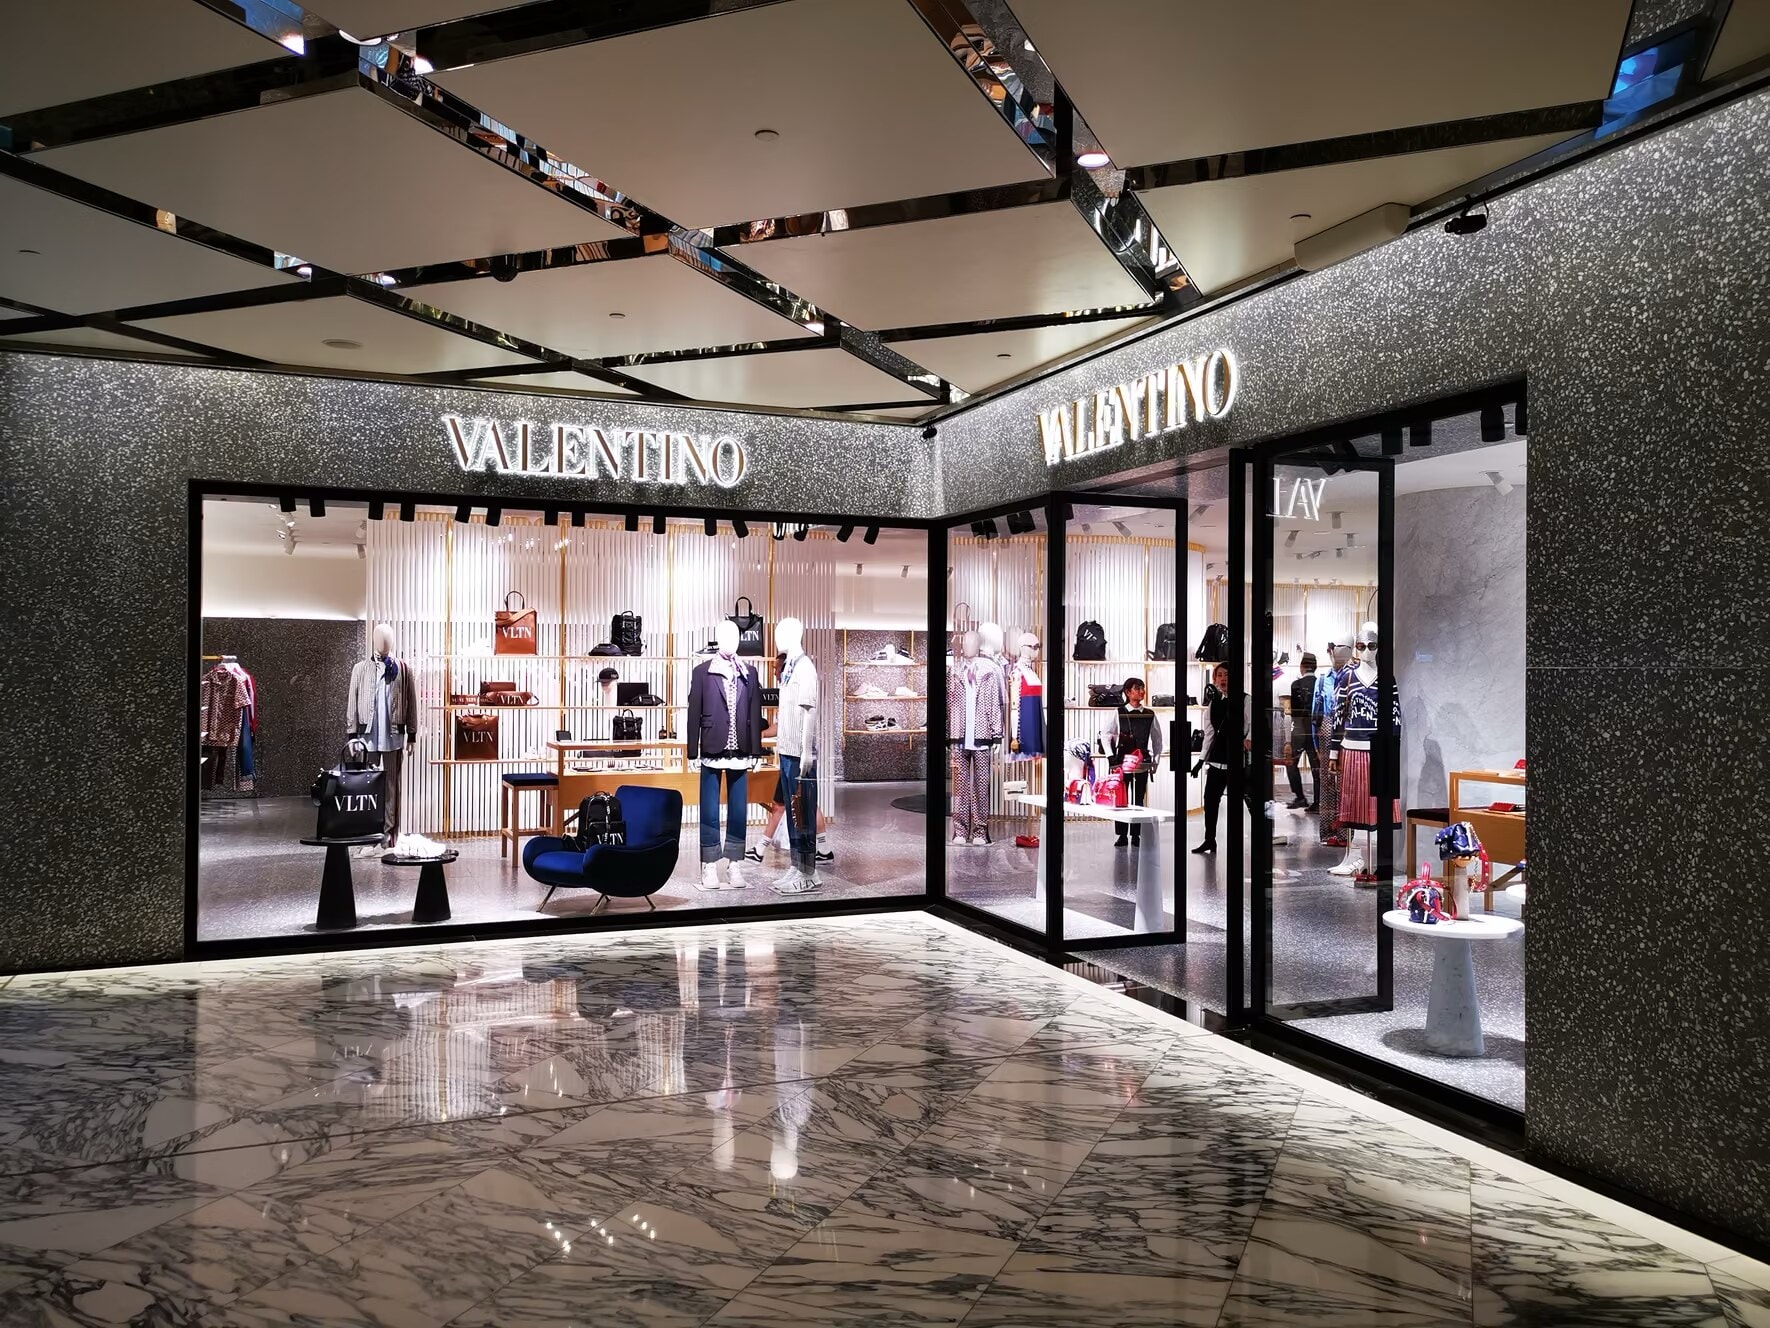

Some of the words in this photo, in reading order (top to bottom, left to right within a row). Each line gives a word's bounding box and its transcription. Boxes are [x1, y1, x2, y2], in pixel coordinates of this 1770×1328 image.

[1037, 349, 1238, 466] VALENTINO
[442, 416, 747, 488] VALENTINO
[502, 627, 532, 639] VLTN
[740, 630, 760, 642] LTN
[500, 695, 524, 705] VLTN
[463, 731, 494, 743] VLTN
[334, 793, 378, 812] VLTN
